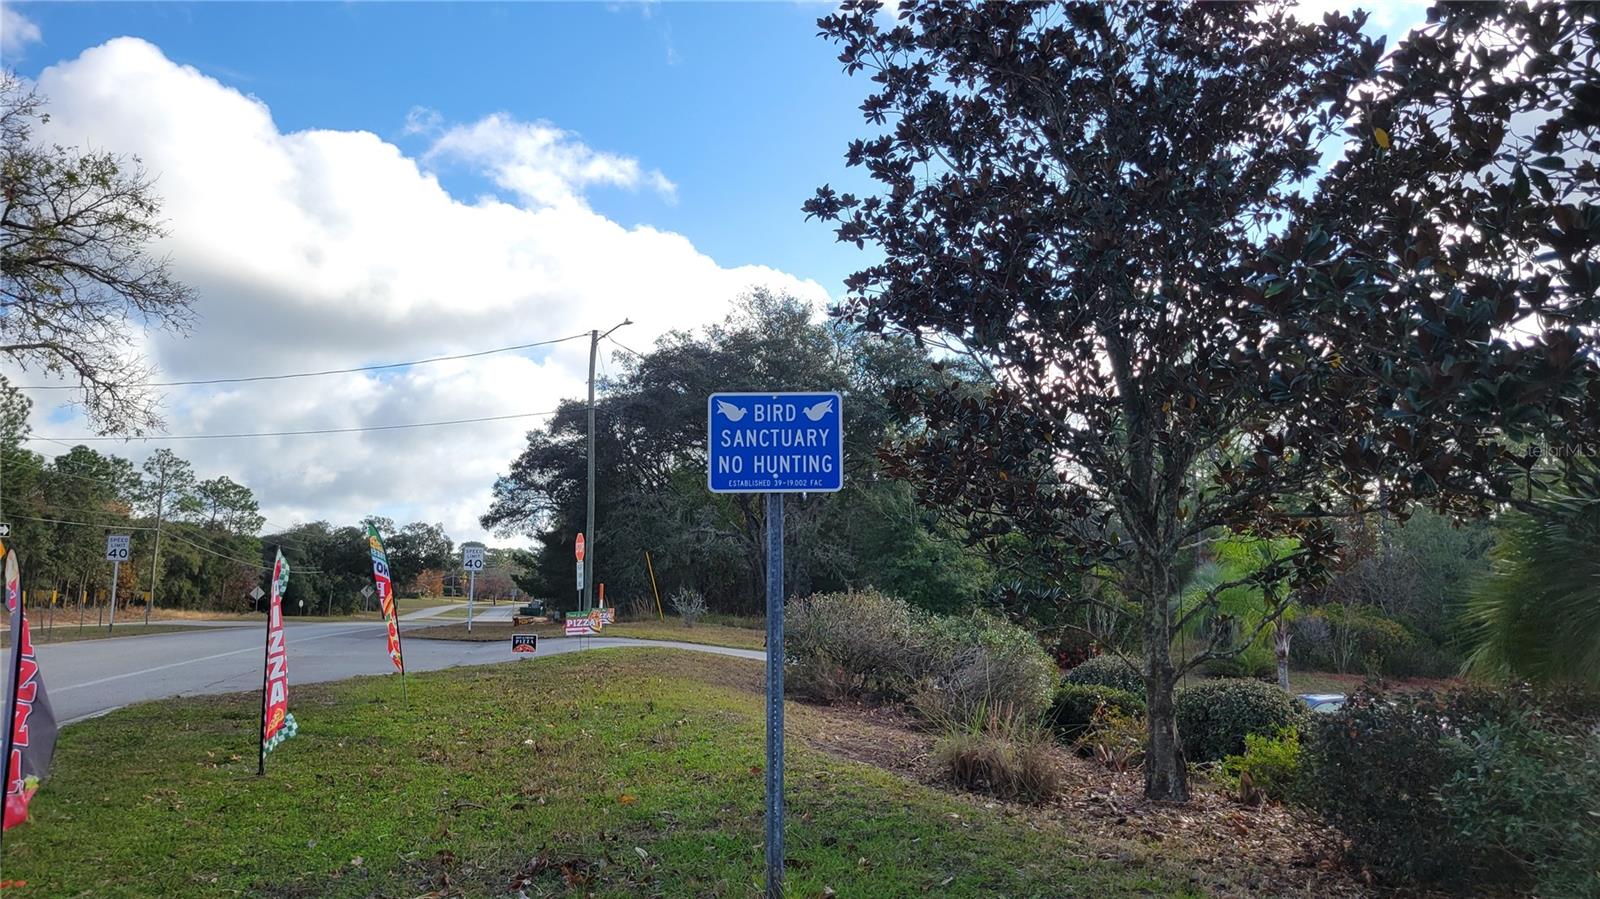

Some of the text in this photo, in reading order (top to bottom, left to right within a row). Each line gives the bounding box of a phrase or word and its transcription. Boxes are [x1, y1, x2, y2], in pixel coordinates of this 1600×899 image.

[754, 404, 797, 422] BIRD
[721, 429, 830, 447] SANCTUARY
[719, 454, 833, 474] NO HUNTING
[728, 479, 771, 487] ESTABLISHED
[810, 479, 823, 487] FAC
[108, 548, 128, 559] 40
[464, 559, 483, 569] 40
[566, 619, 597, 627] PIZZA
[270, 580, 286, 707] PIZZA
